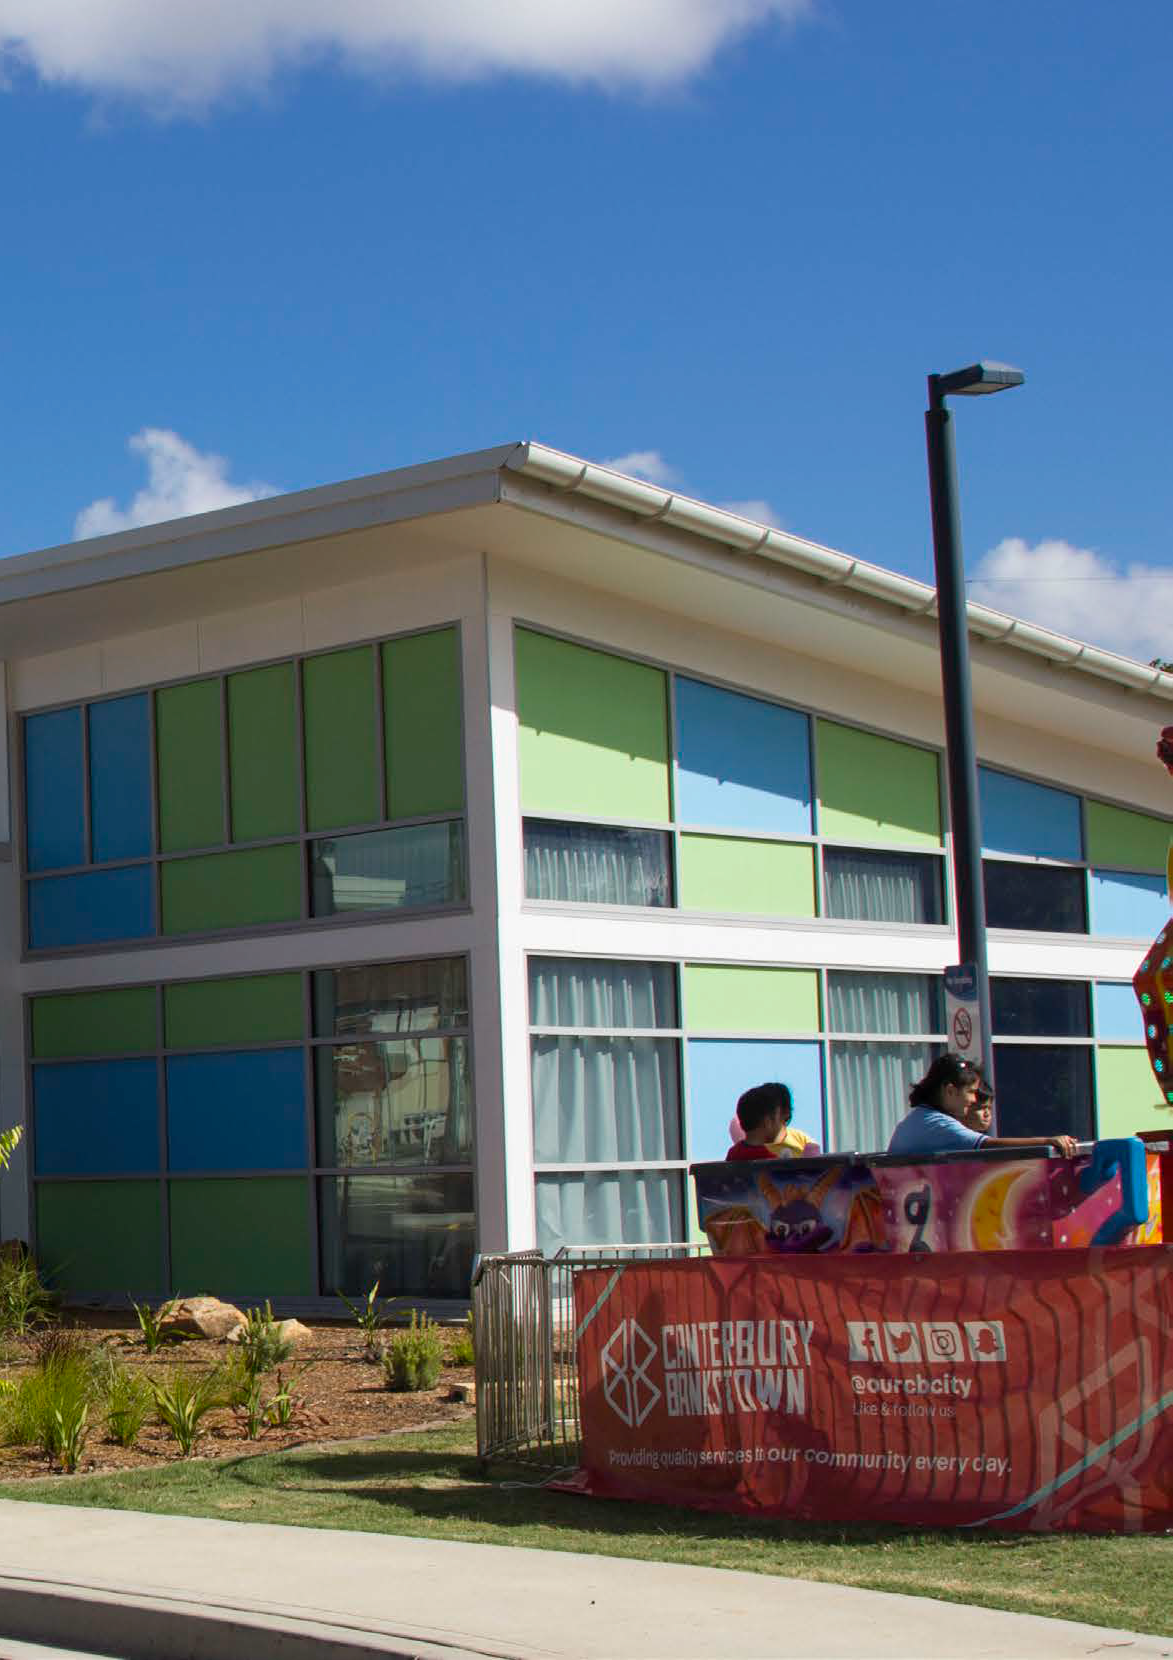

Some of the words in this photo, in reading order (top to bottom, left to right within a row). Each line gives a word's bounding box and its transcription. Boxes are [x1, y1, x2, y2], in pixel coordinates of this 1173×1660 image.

[662, 1320, 814, 1369] CANTERBURY
[666, 1368, 805, 1416] BANKSTOWN
[851, 1373, 972, 1398] @ourcbcity
[853, 1401, 878, 1416] Like
[881, 1401, 891, 1417] &
[893, 1401, 936, 1417] follow
[939, 1406, 956, 1417] us
[610, 1449, 659, 1469] Providing
[661, 1447, 698, 1467] quality
[699, 1448, 753, 1464] services
[767, 1447, 801, 1462] our
[804, 1448, 911, 1472] community
[915, 1457, 969, 1475] every
[971, 1455, 1013, 1476] day.
